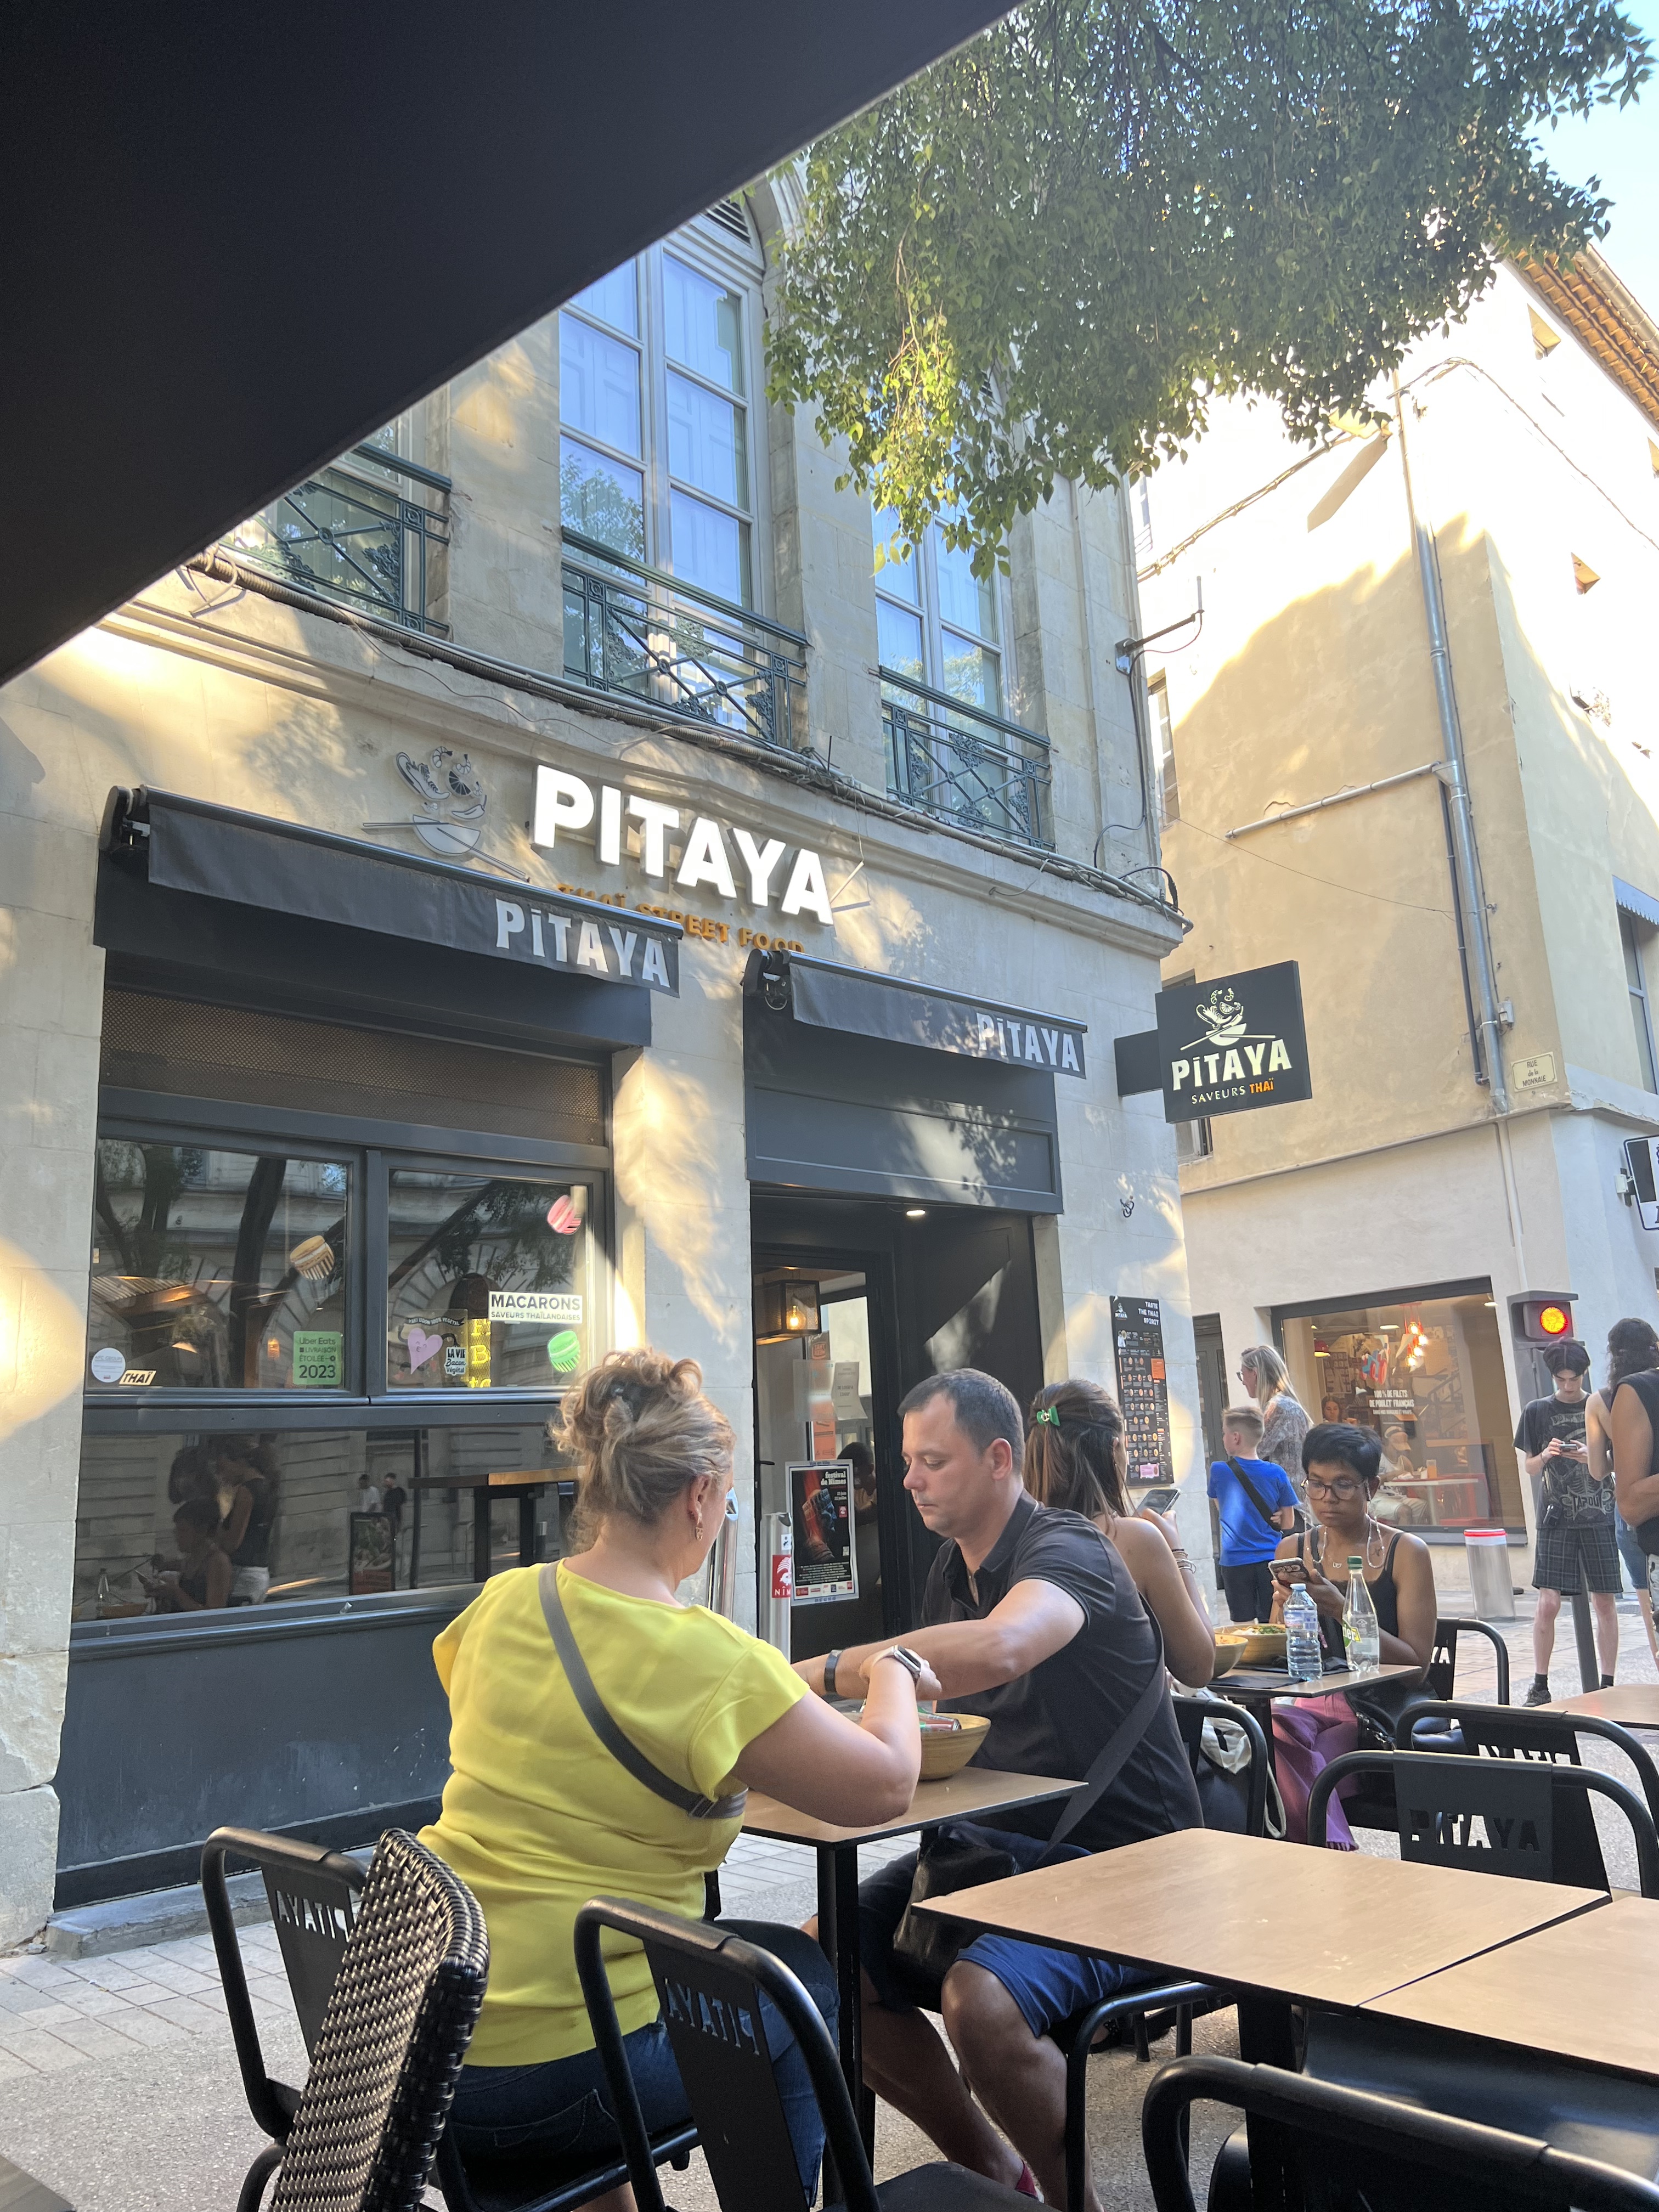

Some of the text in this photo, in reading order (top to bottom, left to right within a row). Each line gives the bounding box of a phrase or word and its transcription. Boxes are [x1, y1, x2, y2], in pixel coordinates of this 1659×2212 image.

[530, 764, 834, 926] PITAYA
[636, 903, 730, 944] STREET
[738, 927, 805, 953] FOOD
[1527, 1059, 1538, 1068] RUE
[1522, 1075, 1546, 1087] MONNAIE
[1192, 1077, 1274, 1104] SAVEURS THAÏ
[491, 1294, 580, 1311] MACARONS
[1145, 1301, 1158, 1310] TASTE
[526, 1311, 580, 1321] THAÏLANDAISES
[1147, 1310, 1159, 1318] THAI
[1143, 1317, 1159, 1325] SPIRIT
[447, 1348, 455, 1358] LA
[445, 1358, 466, 1367] Bacon
[299, 1365, 336, 1379] 2023
[446, 1367, 465, 1375] Végétal
[123, 1371, 153, 1383] THAÏ
[1374, 1390, 1382, 1398] 100
[1387, 1390, 1393, 1398] DE
[1393, 1389, 1408, 1398] FILETS
[1369, 1400, 1375, 1408] DE
[1393, 1399, 1415, 1409] FRANÇAIS
[1571, 1489, 1603, 1513] TAPOUT
[1409, 1809, 1541, 1854] PITAYA
